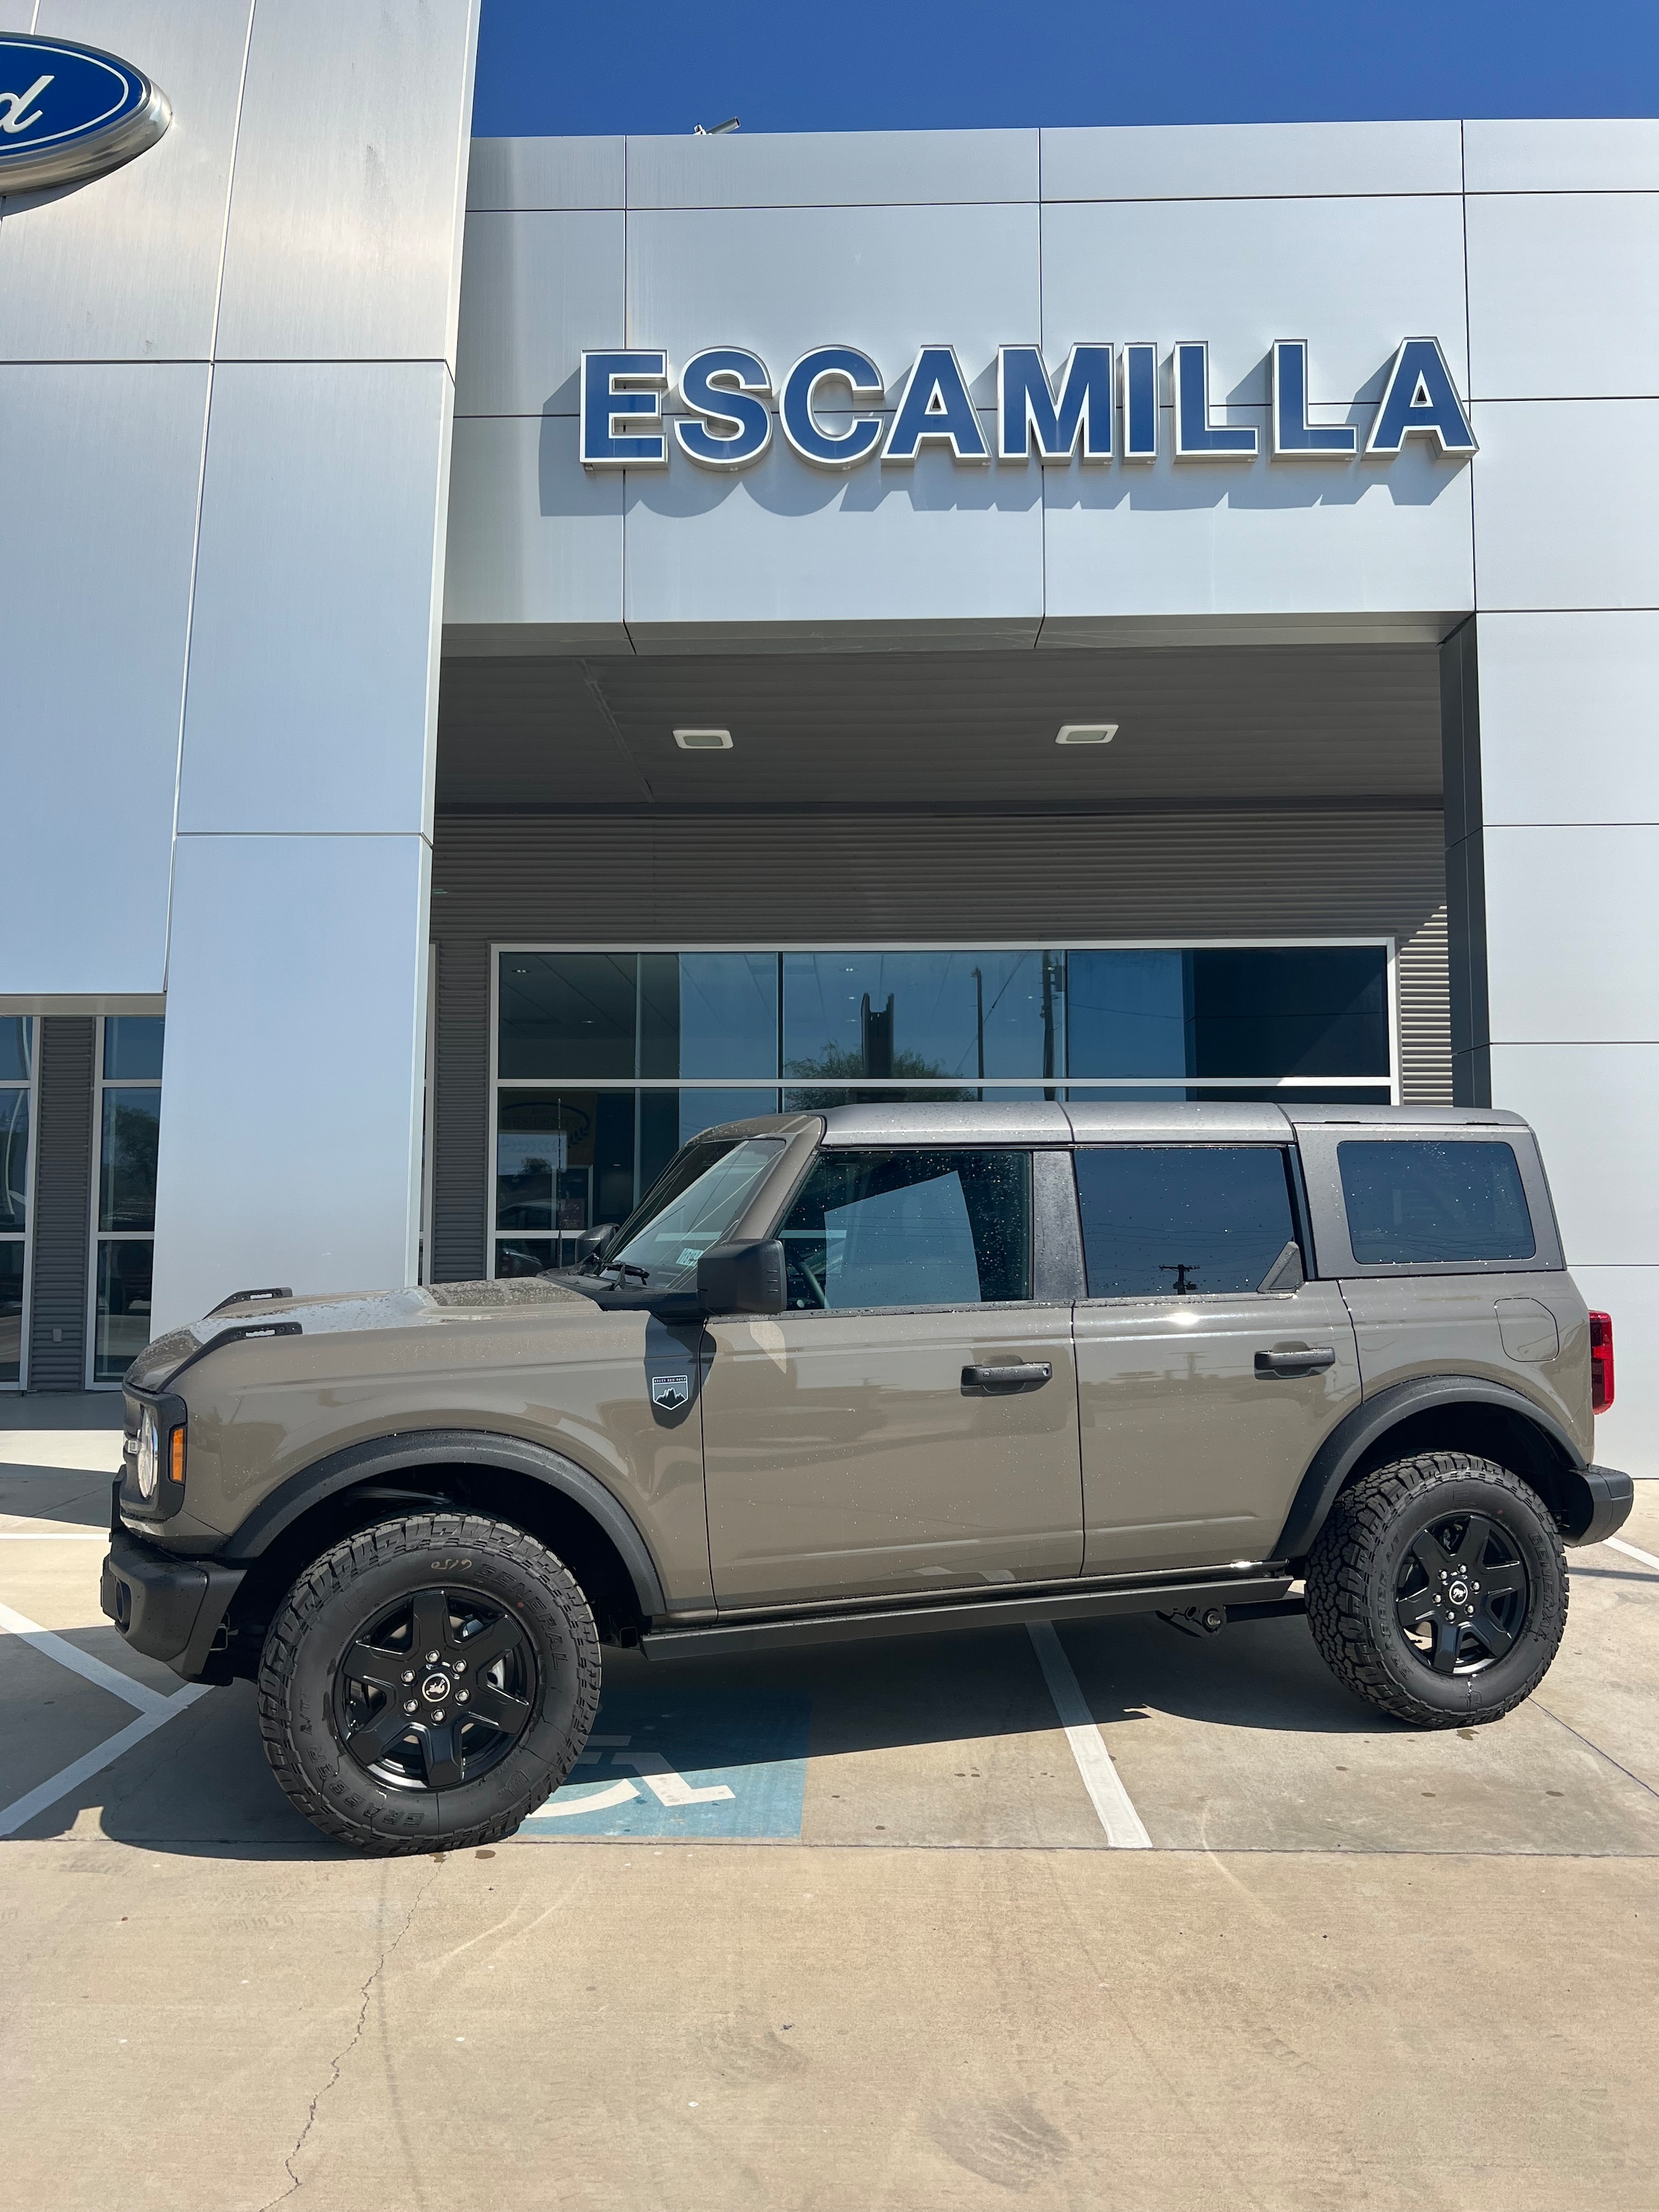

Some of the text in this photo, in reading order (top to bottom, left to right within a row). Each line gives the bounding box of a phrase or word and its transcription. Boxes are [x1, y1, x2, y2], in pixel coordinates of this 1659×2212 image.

[579, 336, 1480, 470] ESCAMILLA
[474, 1563, 569, 1670] GENERAL
[307, 1745, 425, 1828] GRABBER
